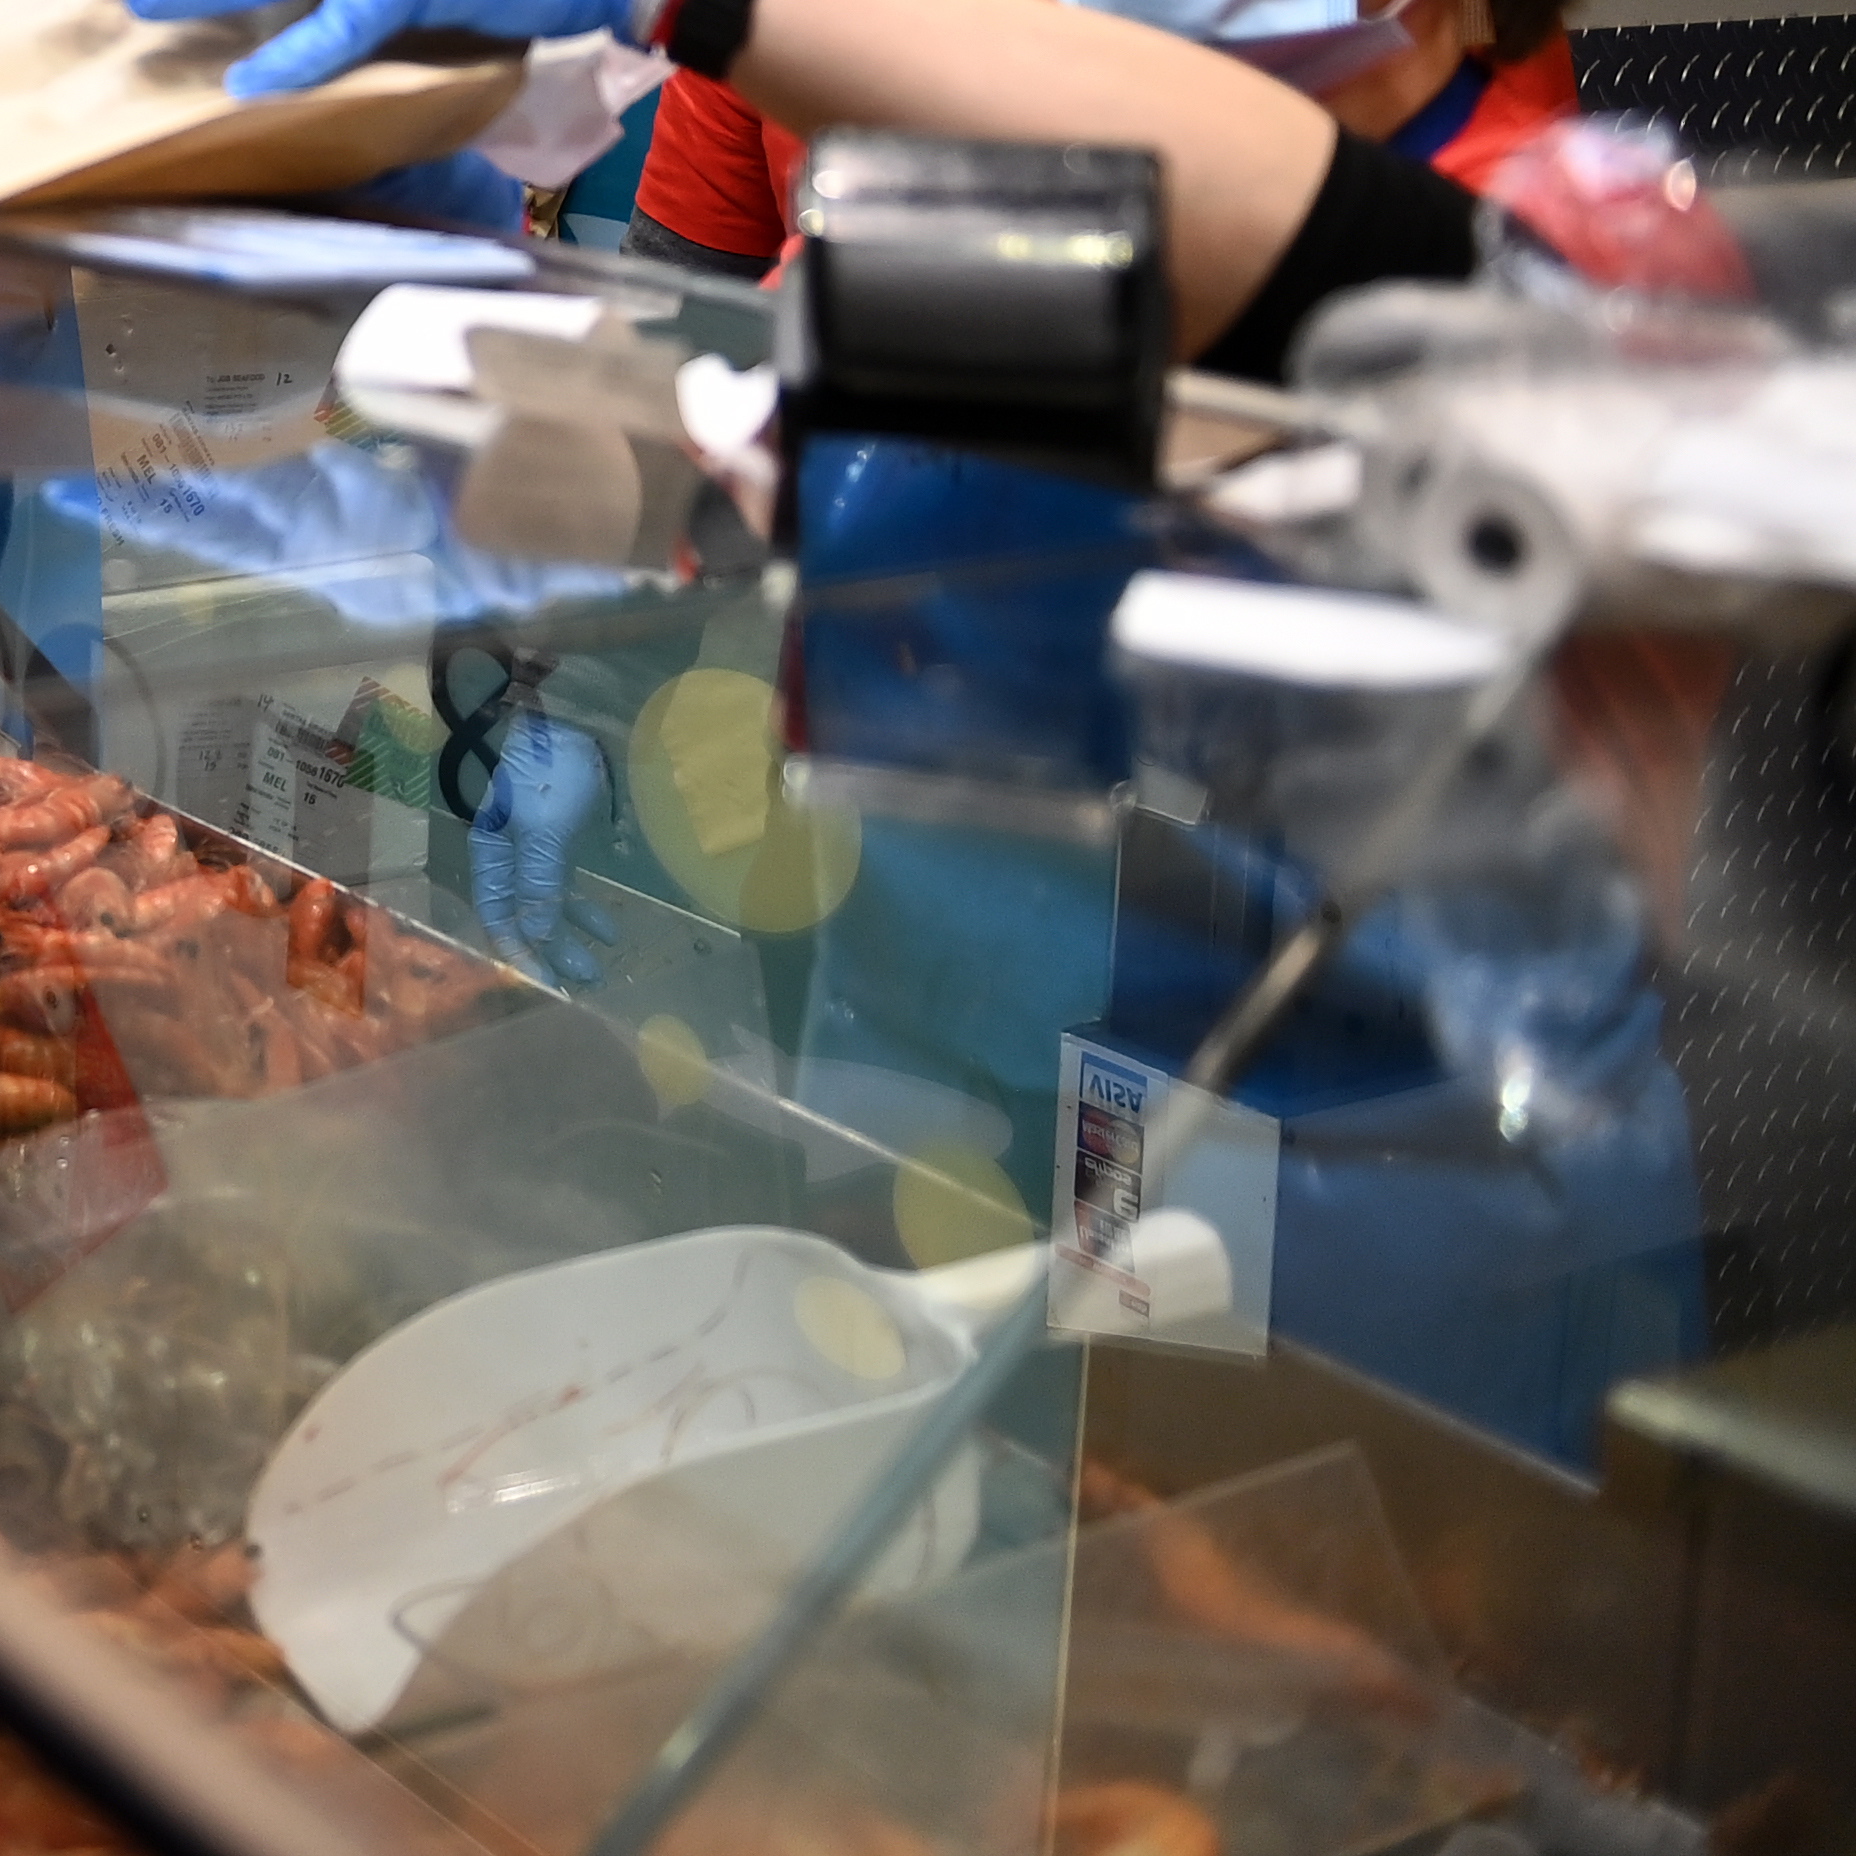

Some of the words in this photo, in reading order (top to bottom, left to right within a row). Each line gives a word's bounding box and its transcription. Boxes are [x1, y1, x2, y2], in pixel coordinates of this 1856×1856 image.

[276, 372, 293, 386] 12
[136, 453, 157, 485] MEL
[183, 487, 205, 517] 1670
[262, 771, 287, 793] MEL
[267, 746, 285, 763] 081
[295, 758, 318, 777] 1056
[318, 765, 345, 789] 1670
